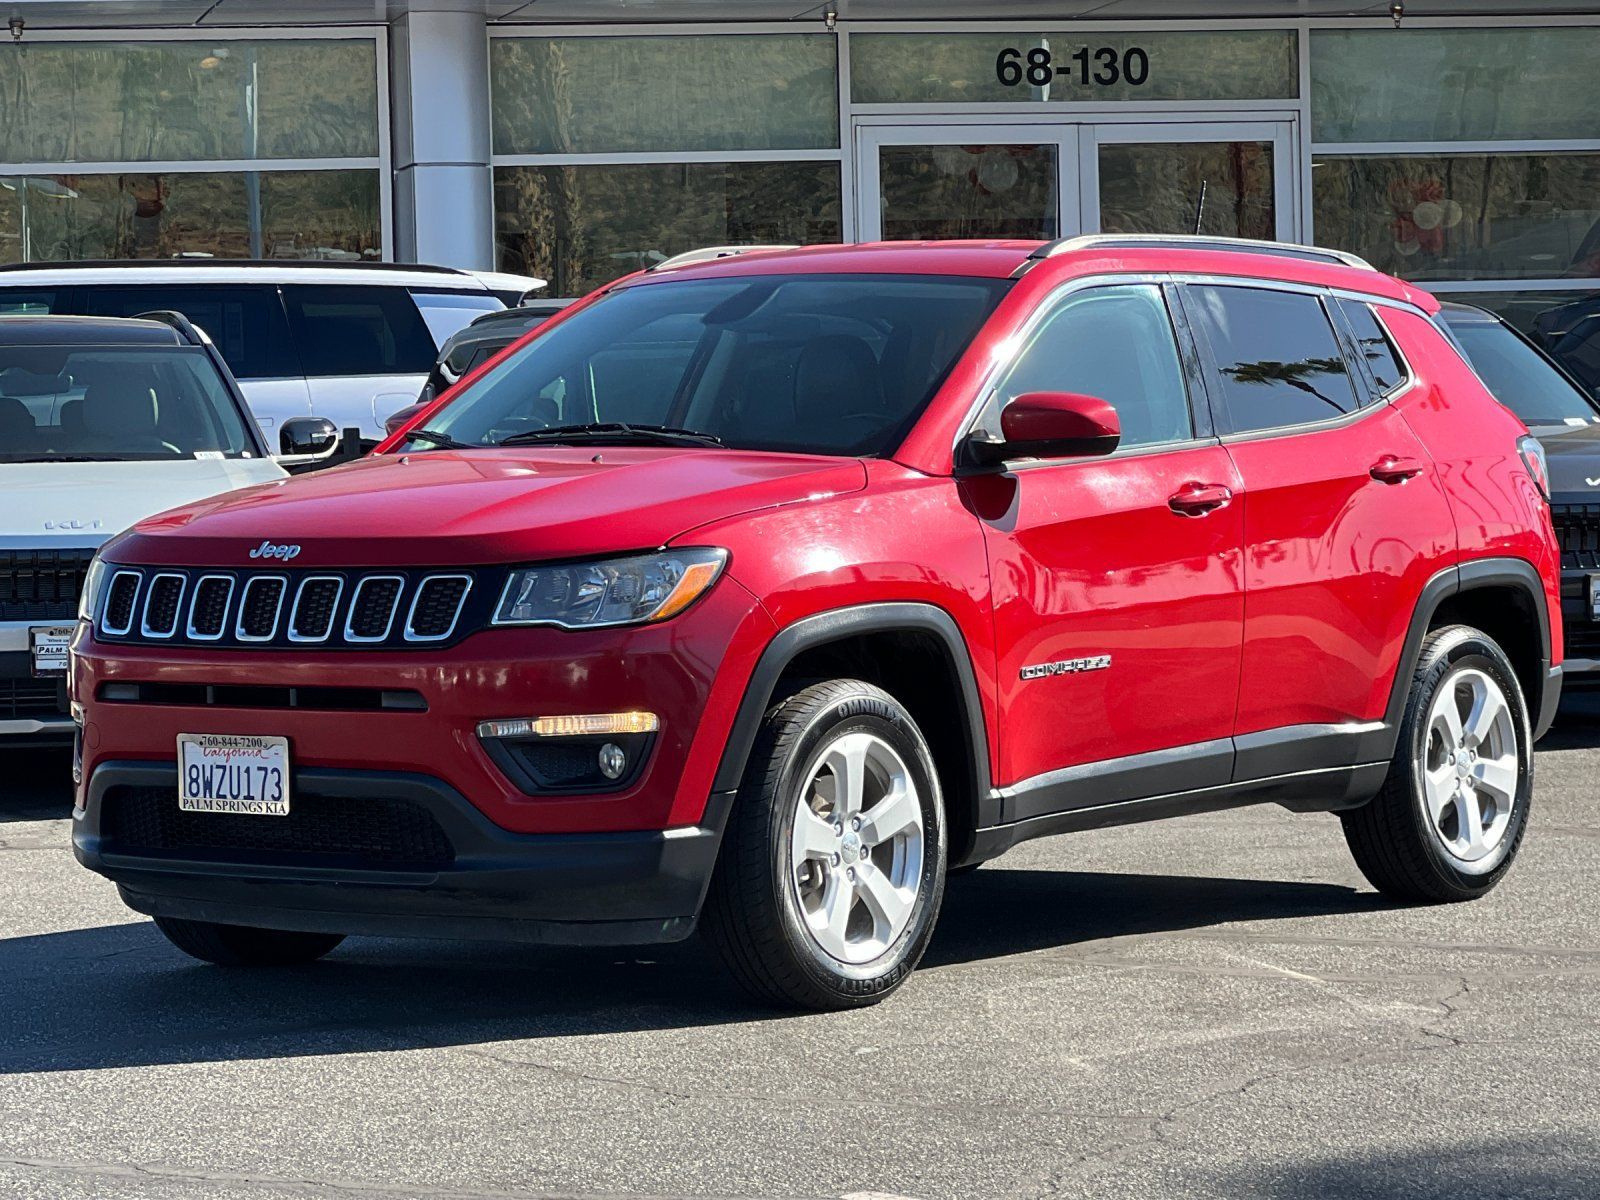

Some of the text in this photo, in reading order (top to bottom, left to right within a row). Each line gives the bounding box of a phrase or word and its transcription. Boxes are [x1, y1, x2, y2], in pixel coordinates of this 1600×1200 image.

[996, 47, 1149, 86] 68-130
[249, 540, 301, 562] Jeep
[38, 646, 63, 654] PALM
[837, 699, 902, 728] OMNIMAX
[201, 735, 263, 749] 760-844-7200
[203, 747, 271, 764] California
[188, 763, 283, 802] 8WZU173
[182, 798, 287, 815] PALM SPRINGS KIA
[838, 961, 911, 994] VELOCITY
